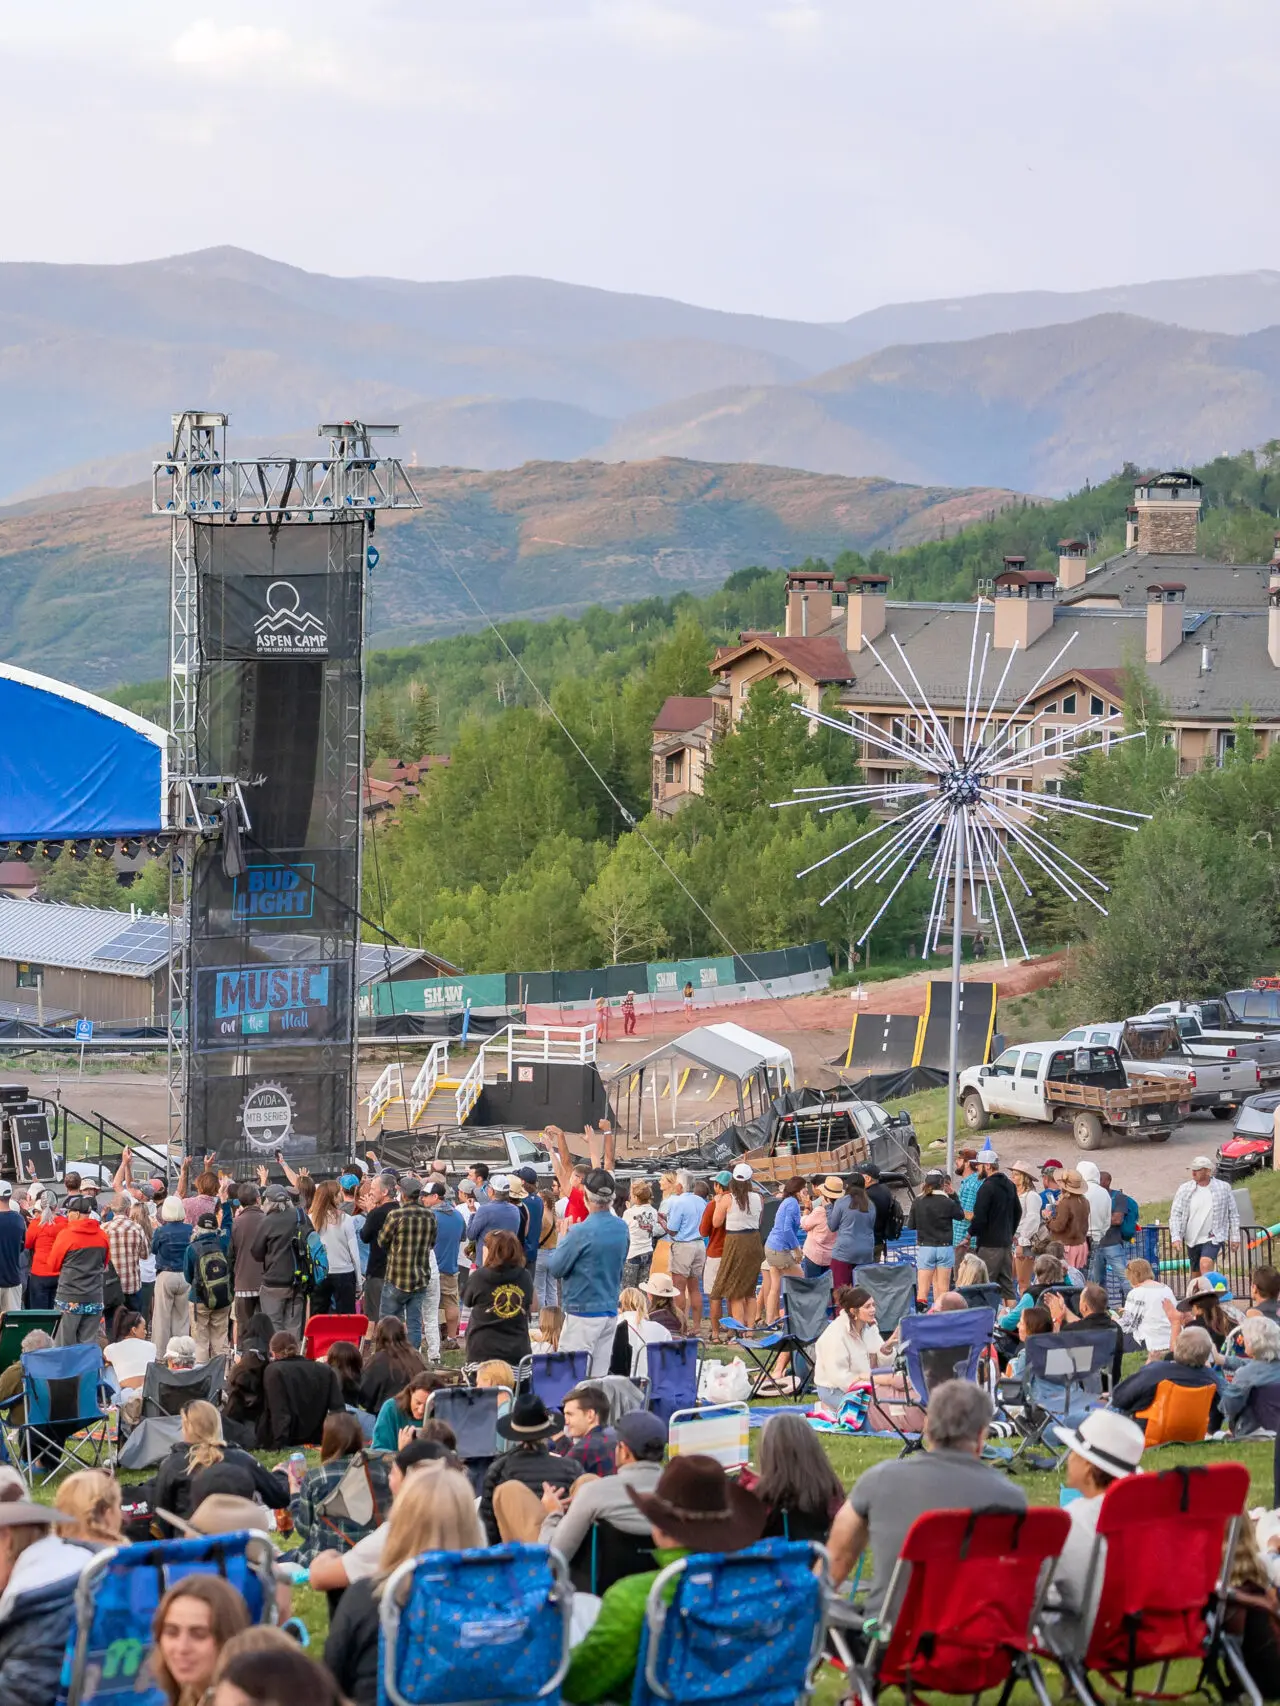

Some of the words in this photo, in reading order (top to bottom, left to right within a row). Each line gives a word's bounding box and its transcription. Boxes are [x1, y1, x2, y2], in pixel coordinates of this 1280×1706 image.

[256, 634, 292, 647] ASPEN
[294, 634, 328, 647] CAMP
[248, 870, 301, 892] BUD
[237, 891, 308, 915] LIGHT
[221, 966, 322, 1014] MUSIC
[423, 985, 464, 1004] SHAW
[257, 1094, 277, 1107] VIDA
[246, 1112, 261, 1123] MTB
[263, 1110, 288, 1122] SERIES
